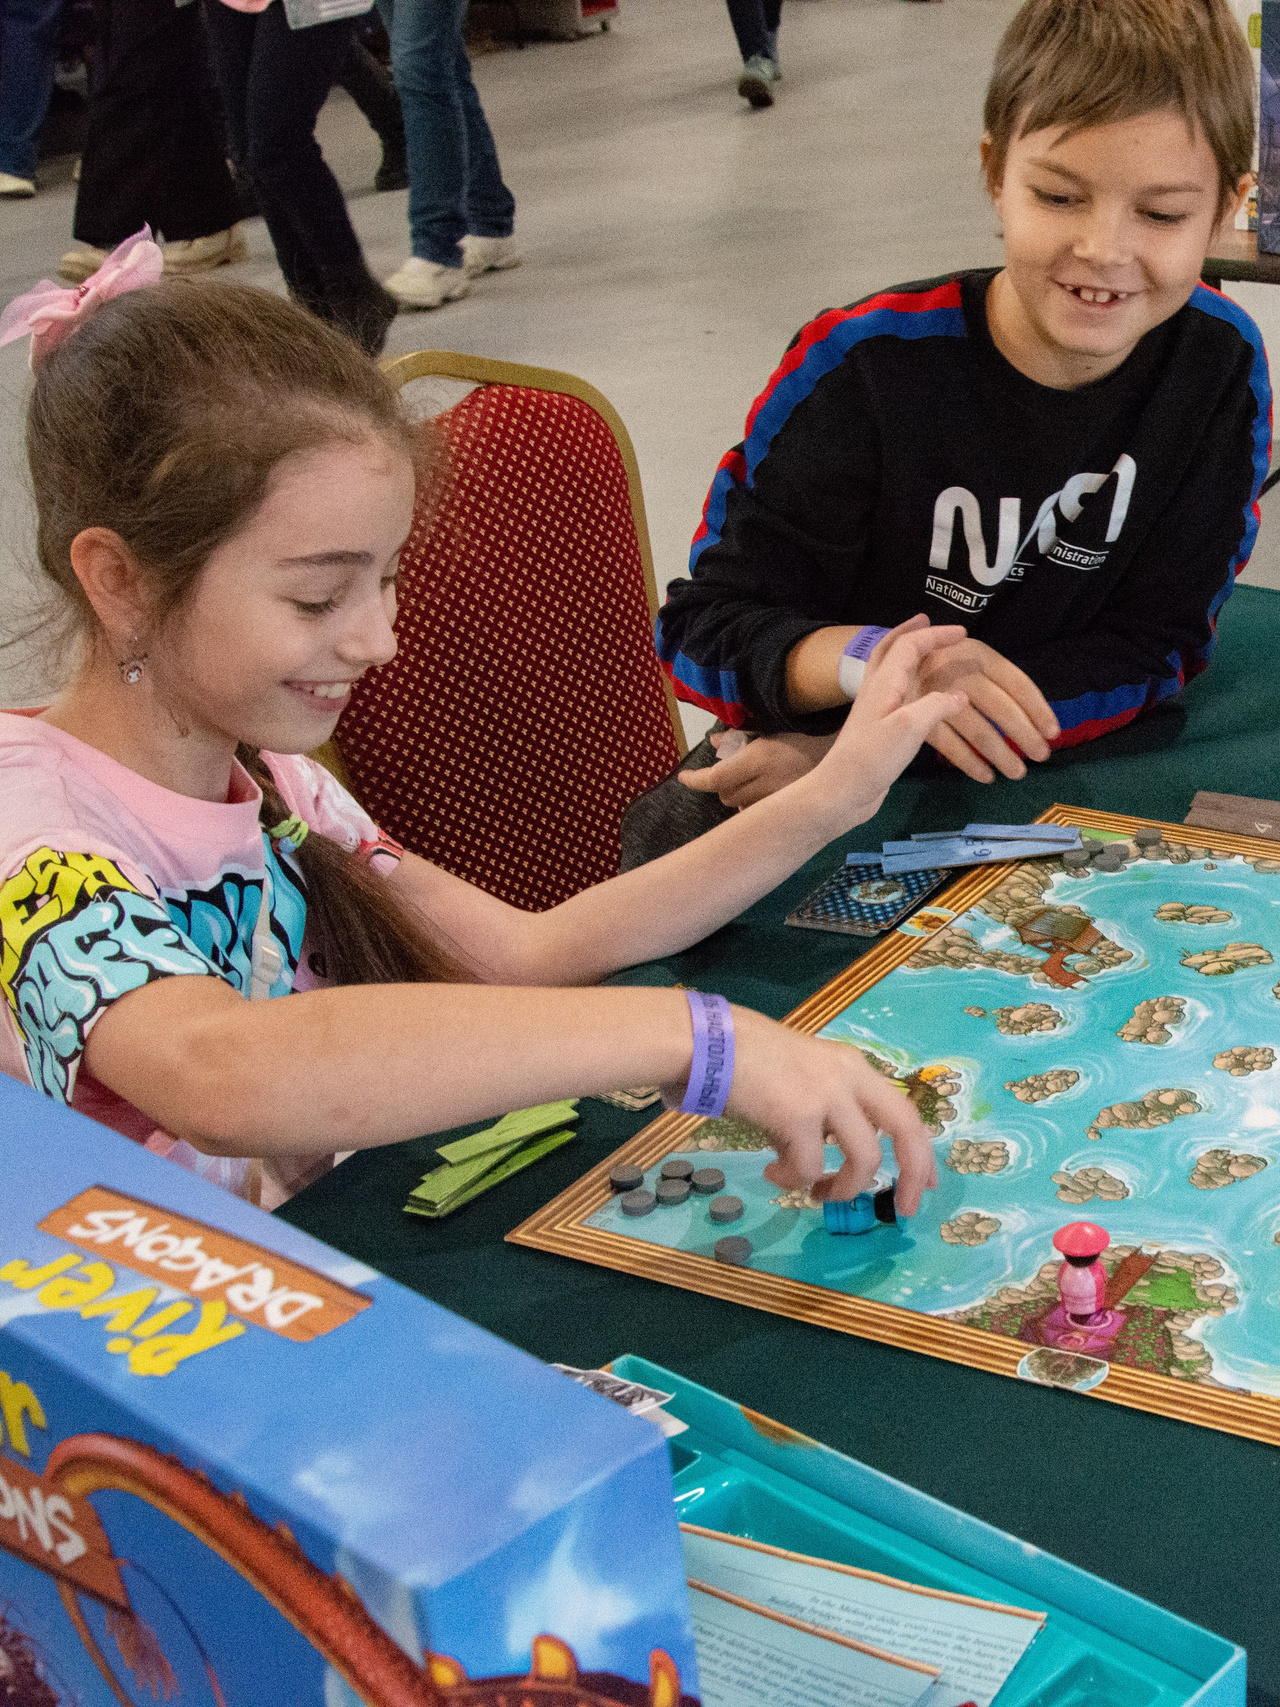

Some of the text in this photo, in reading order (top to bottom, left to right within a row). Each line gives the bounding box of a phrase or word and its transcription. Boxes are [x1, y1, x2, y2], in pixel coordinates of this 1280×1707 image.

[925, 576, 977, 609] National
[1053, 545, 1106, 566] nistration
[67, 1209, 324, 1328] DRAGONS
[0, 1253, 247, 1376] River
